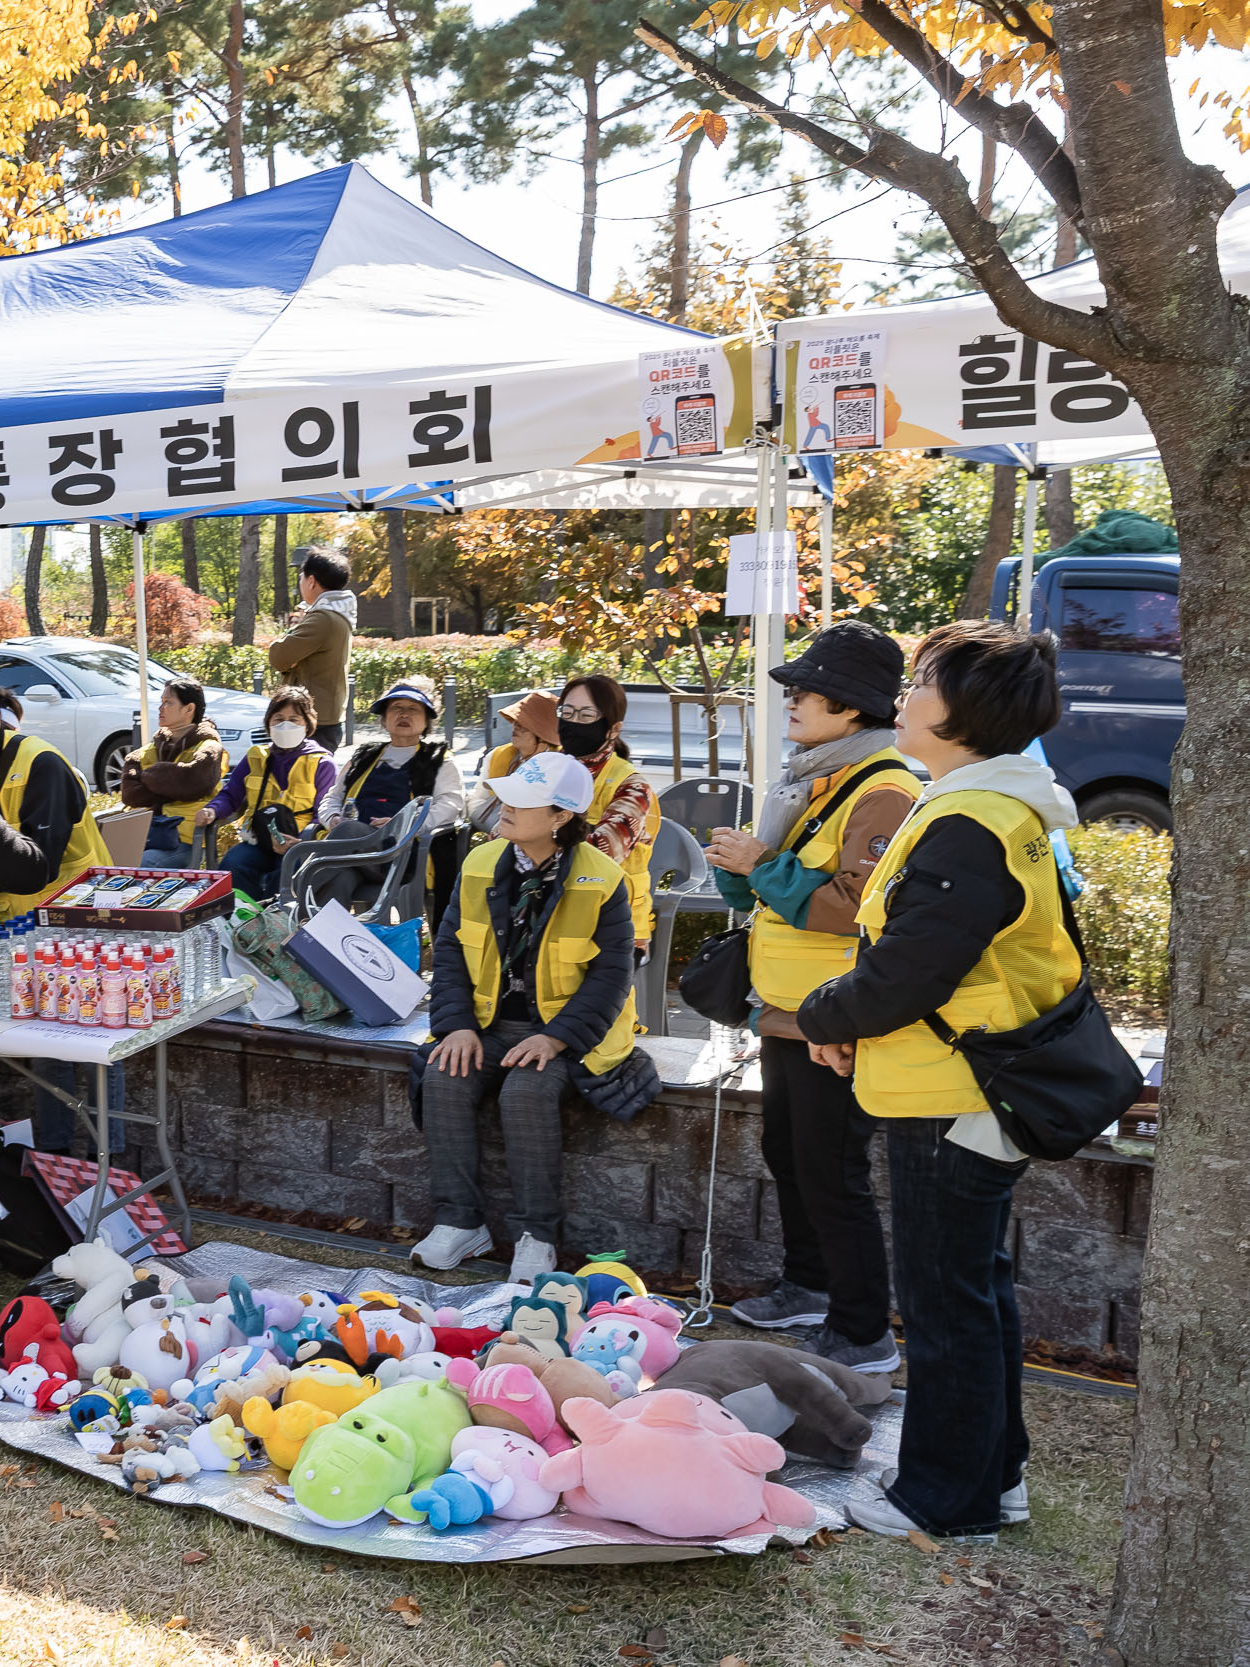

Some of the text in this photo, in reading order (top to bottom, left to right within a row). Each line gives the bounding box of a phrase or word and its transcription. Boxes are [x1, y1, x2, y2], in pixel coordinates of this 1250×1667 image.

[809, 351, 872, 370] QR코드를
[649, 363, 710, 382] QR코드를
[808, 368, 873, 383] 스캔해주세요
[651, 379, 712, 395] 스캔해주세요
